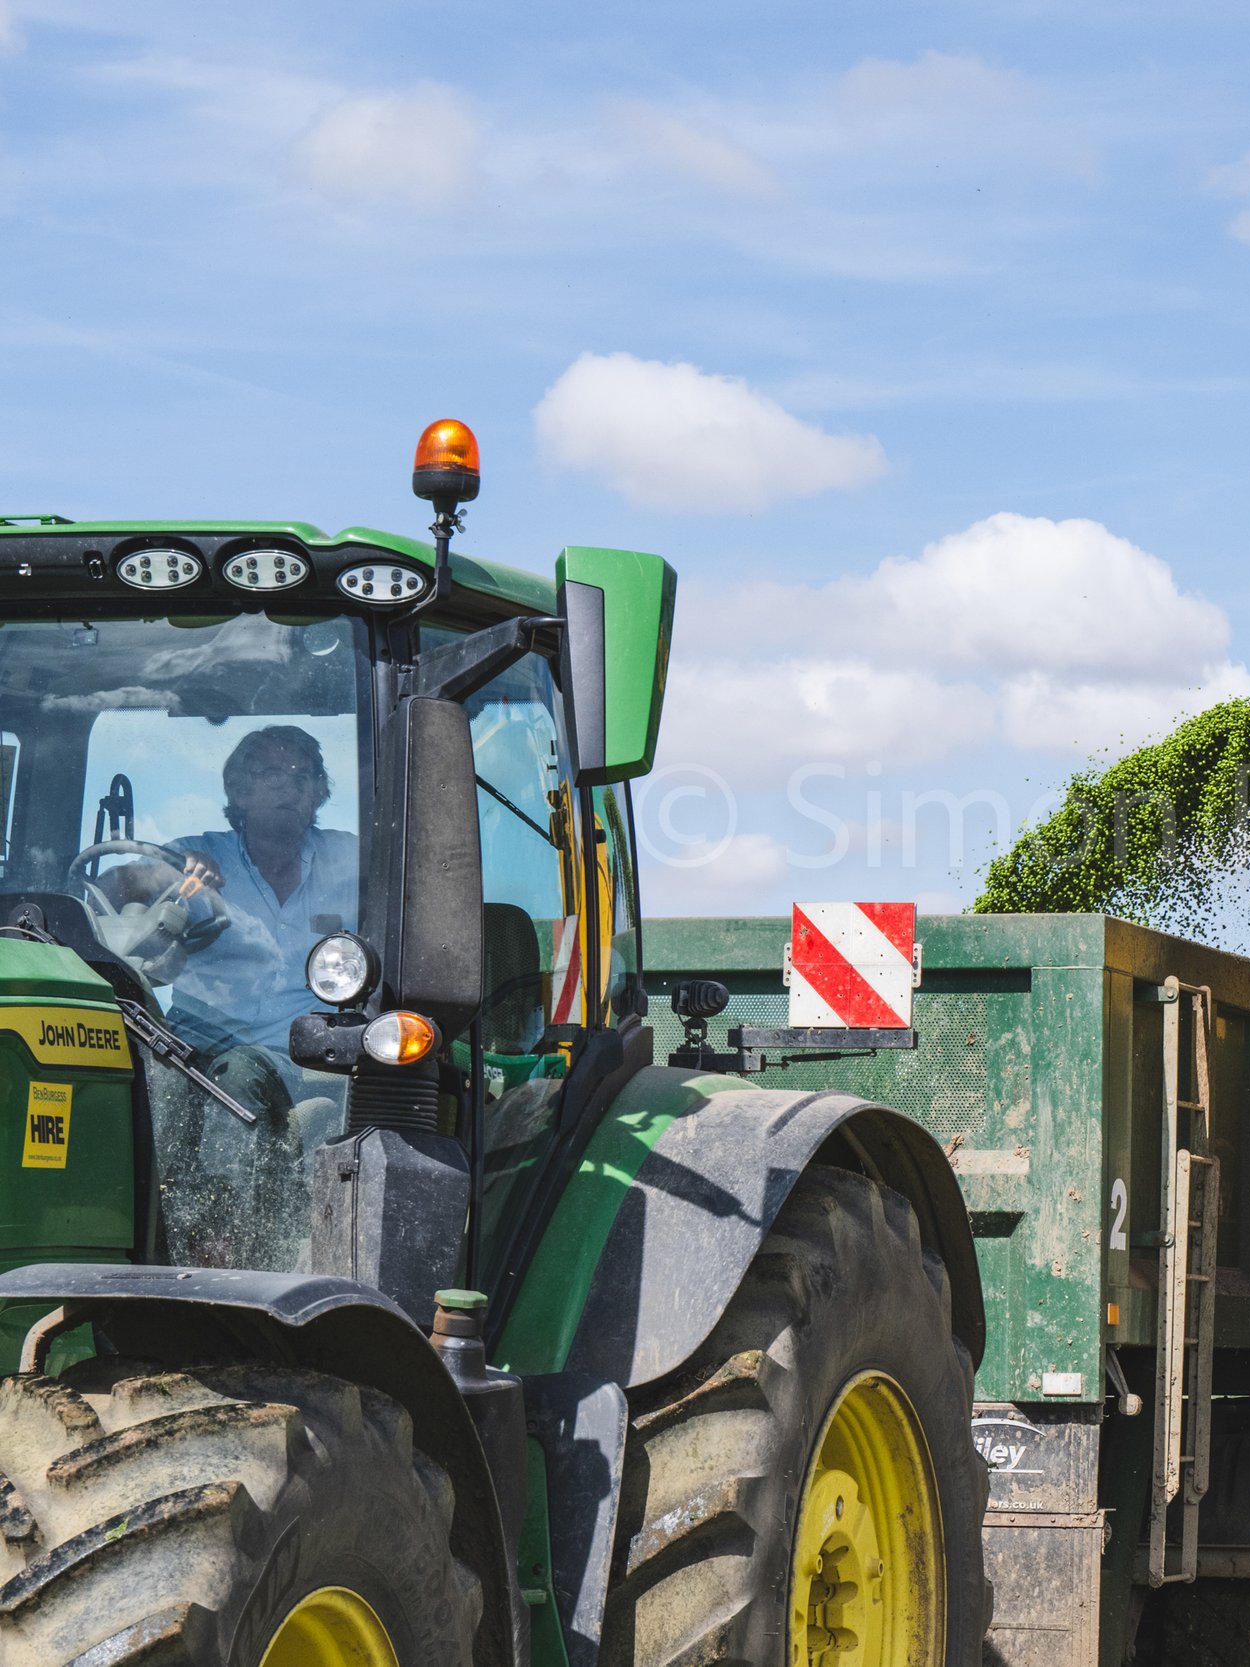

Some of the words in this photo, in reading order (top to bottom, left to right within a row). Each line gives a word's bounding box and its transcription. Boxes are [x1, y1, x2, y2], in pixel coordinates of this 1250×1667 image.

[38, 1020, 76, 1048] JOHN
[77, 1022, 121, 1050] DEERE
[30, 1114, 65, 1145] HIRE
[1109, 1177, 1128, 1251] 2
[975, 1436, 1028, 1471] iley
